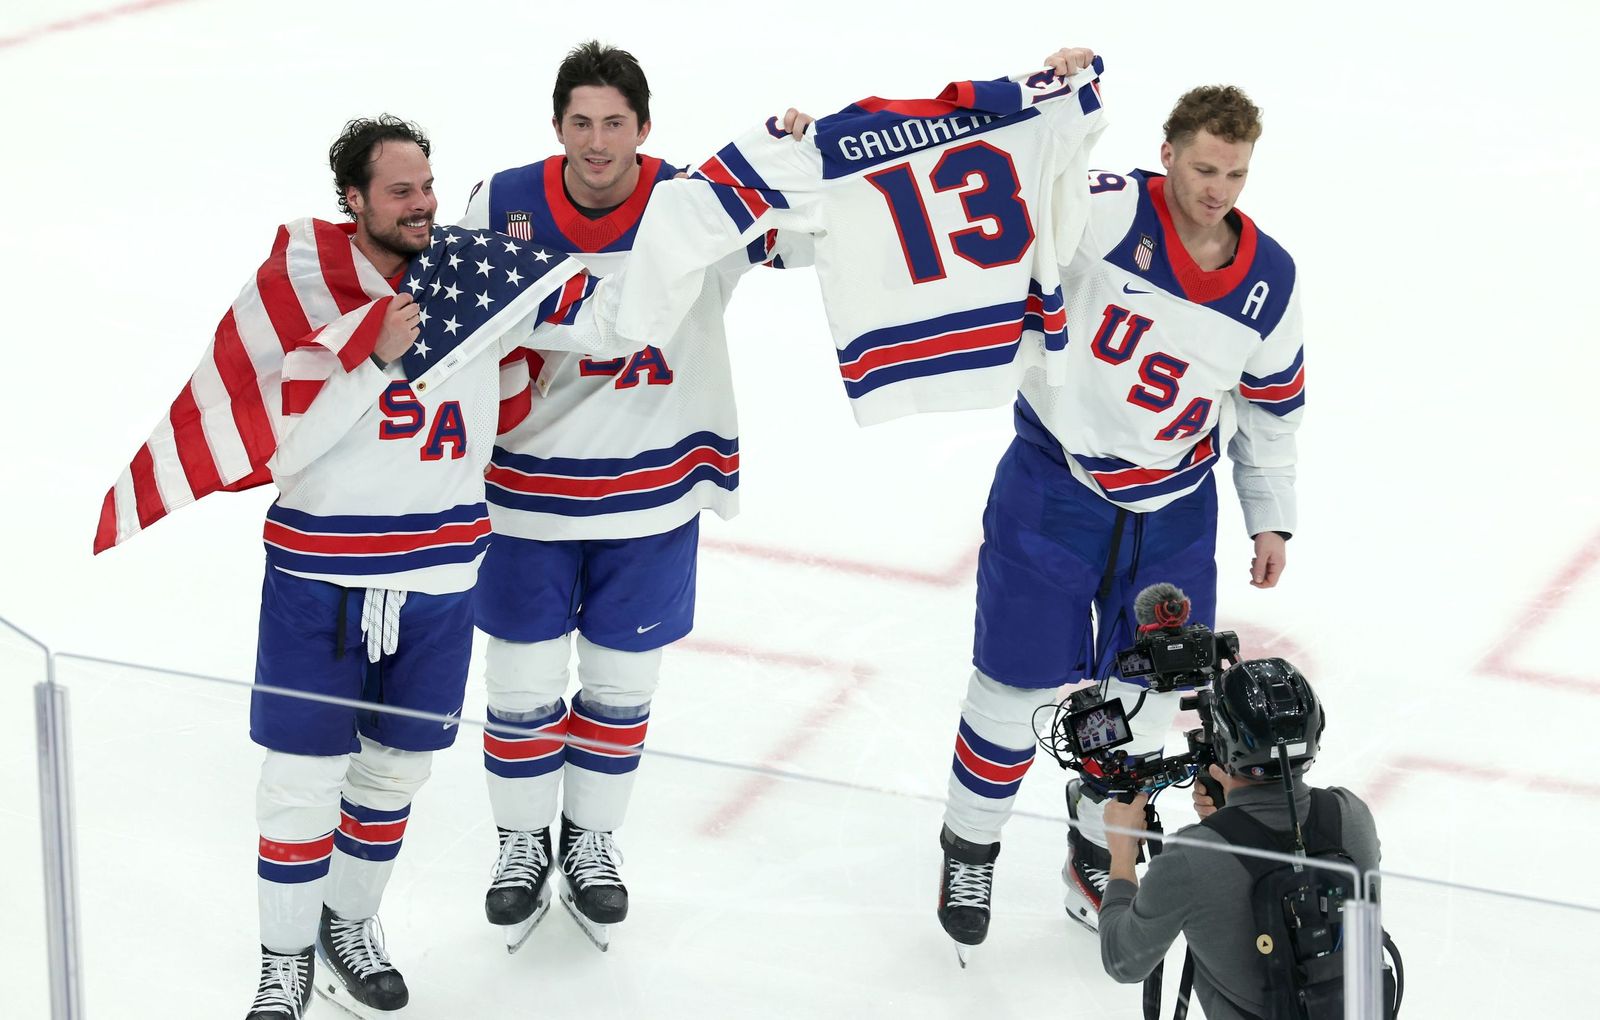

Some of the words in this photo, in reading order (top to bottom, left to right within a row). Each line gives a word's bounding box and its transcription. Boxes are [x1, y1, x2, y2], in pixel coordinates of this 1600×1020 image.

[838, 115, 992, 161] GAUDRE
[510, 213, 528, 222] USA
[863, 139, 1036, 285] 13
[1142, 237, 1154, 250] USA
[1241, 280, 1270, 321] A
[1090, 303, 1214, 441] USA
